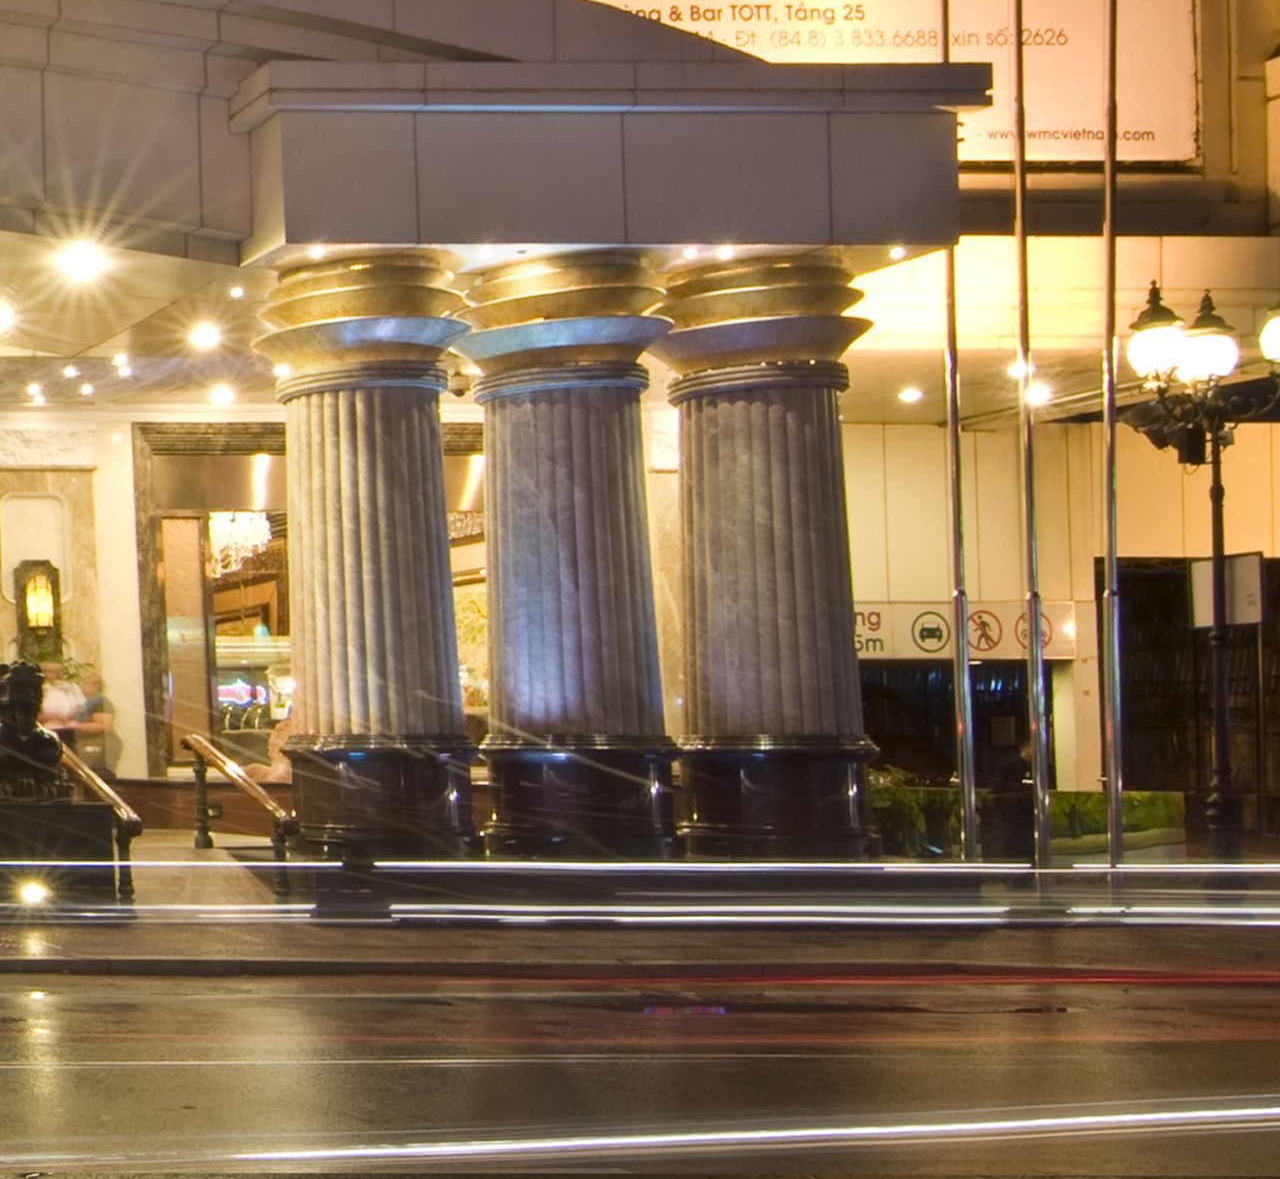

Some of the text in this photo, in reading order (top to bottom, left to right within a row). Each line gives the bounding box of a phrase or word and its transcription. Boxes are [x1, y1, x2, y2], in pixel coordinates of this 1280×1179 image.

[669, 6, 683, 21] &
[690, 5, 723, 21] Bar
[842, 4, 866, 21] 25
[951, 29, 979, 46] xin
[1021, 28, 1069, 47] 2626
